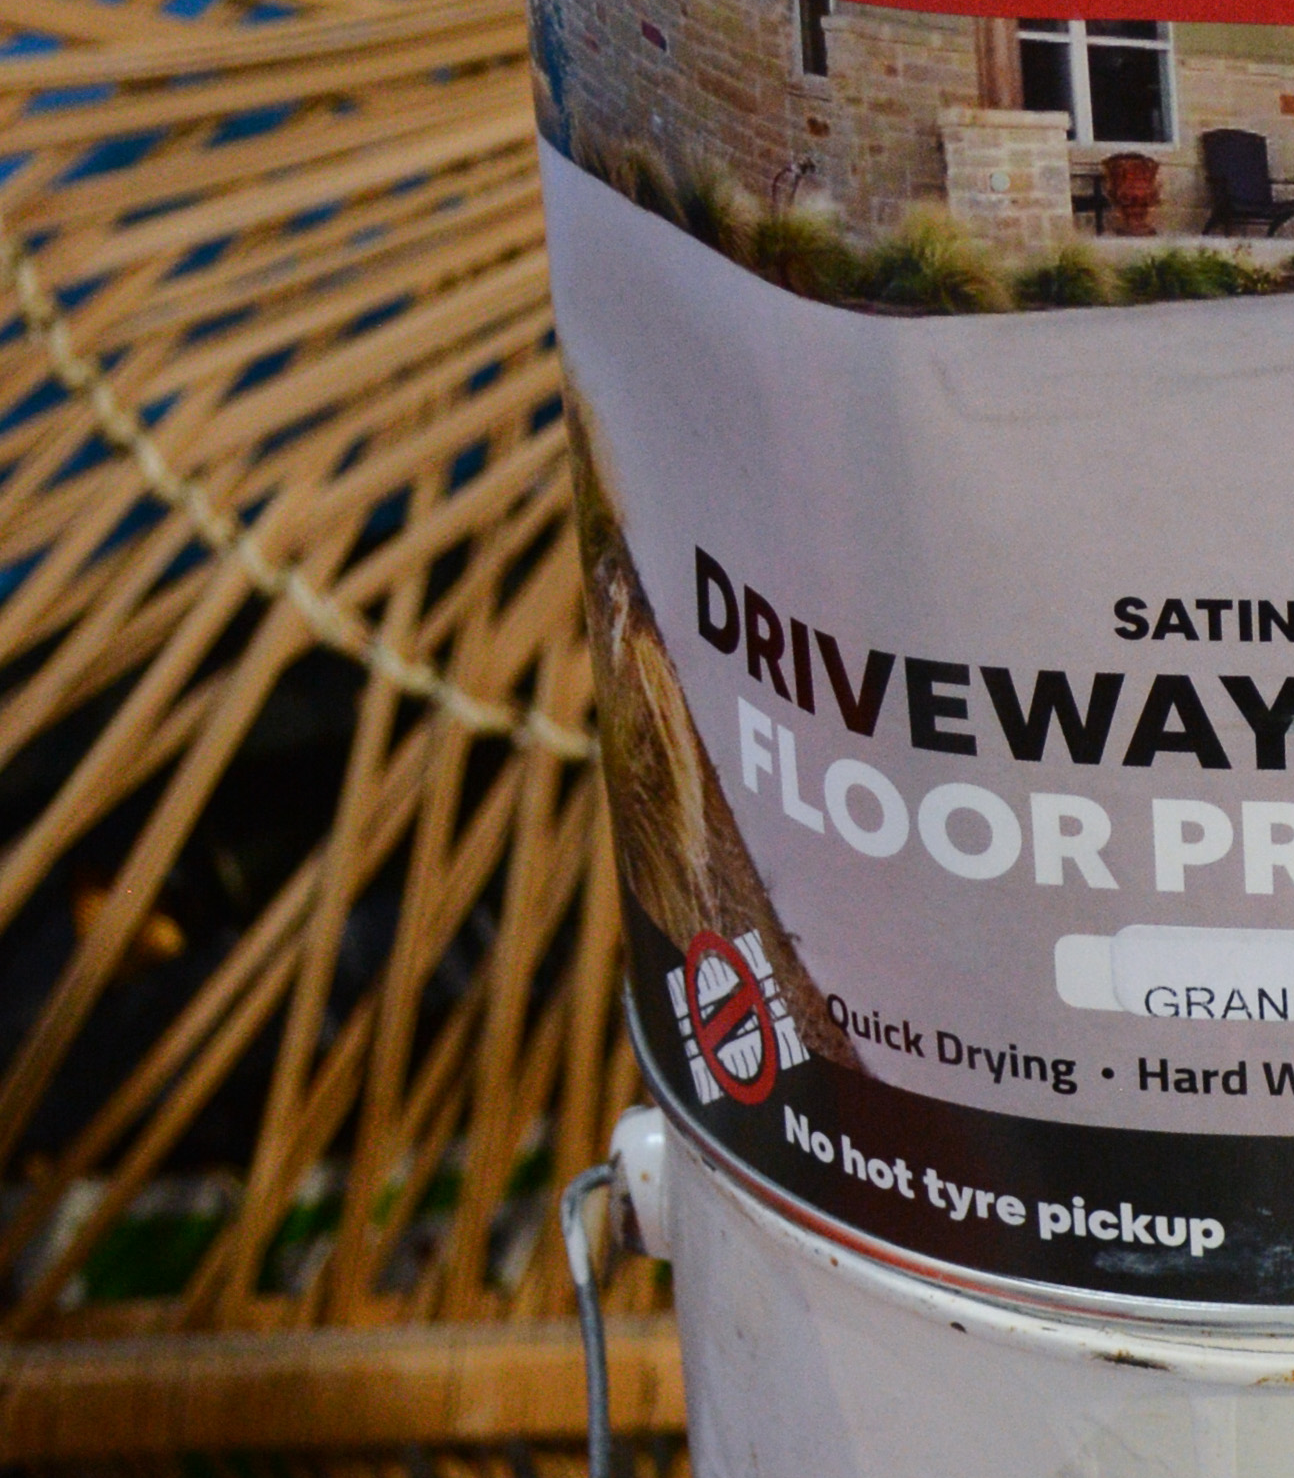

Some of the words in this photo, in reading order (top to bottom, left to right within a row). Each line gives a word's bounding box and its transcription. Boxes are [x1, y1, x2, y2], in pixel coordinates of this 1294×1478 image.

[737, 695, 1121, 891] FLOOR
[826, 992, 924, 1059] Quick
[936, 1030, 1078, 1096] Drying
[1137, 1056, 1248, 1097] Hard
[783, 1104, 835, 1164] No
[842, 1132, 915, 1200] hot
[922, 1166, 1026, 1227] tyre
[1037, 1196, 1226, 1257] pickup
